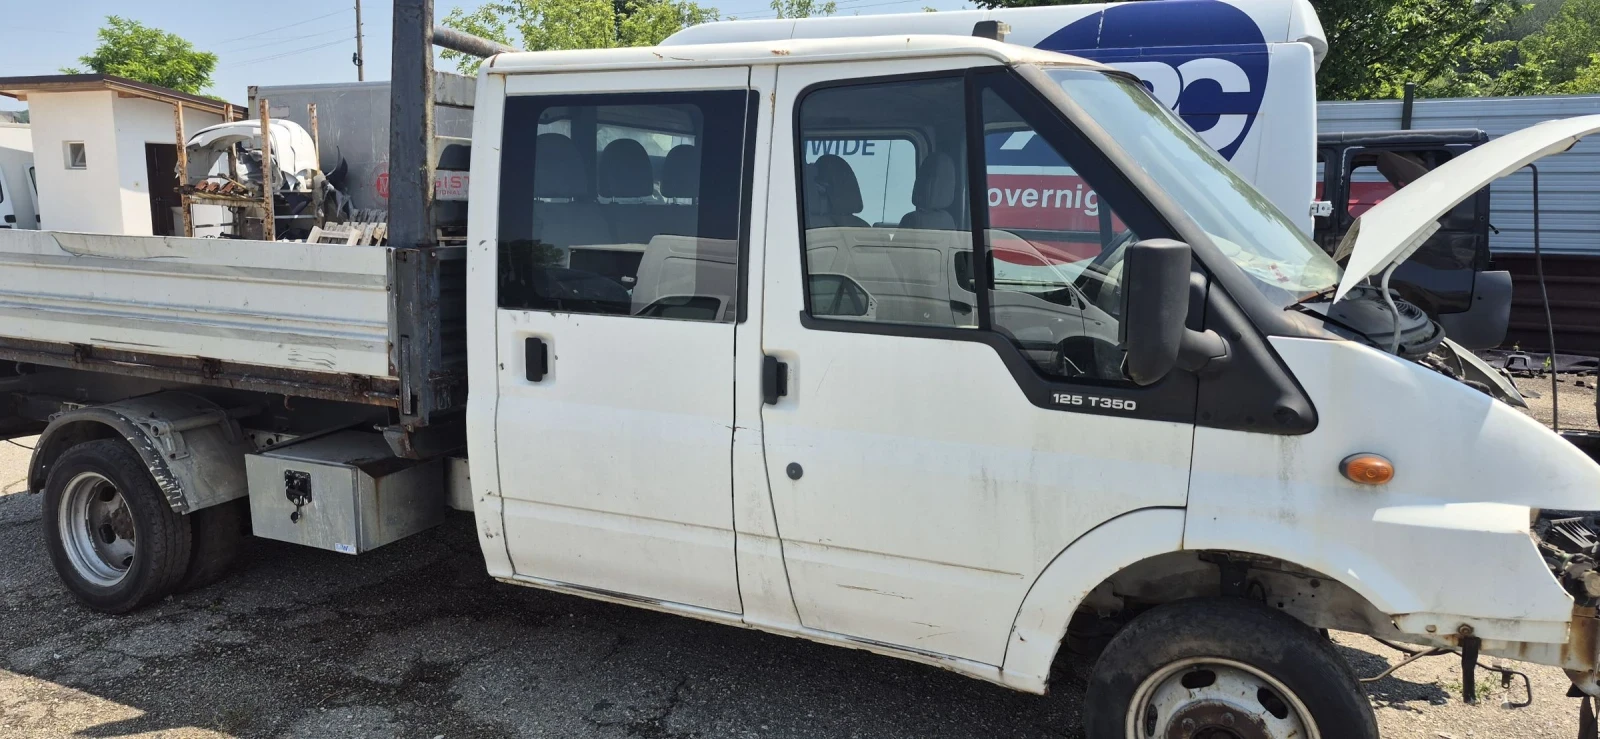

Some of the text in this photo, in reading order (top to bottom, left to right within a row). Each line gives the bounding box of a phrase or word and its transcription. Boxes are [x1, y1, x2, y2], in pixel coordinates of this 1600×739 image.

[804, 141, 875, 156] WIDE
[1053, 393, 1137, 411] 125 T350
